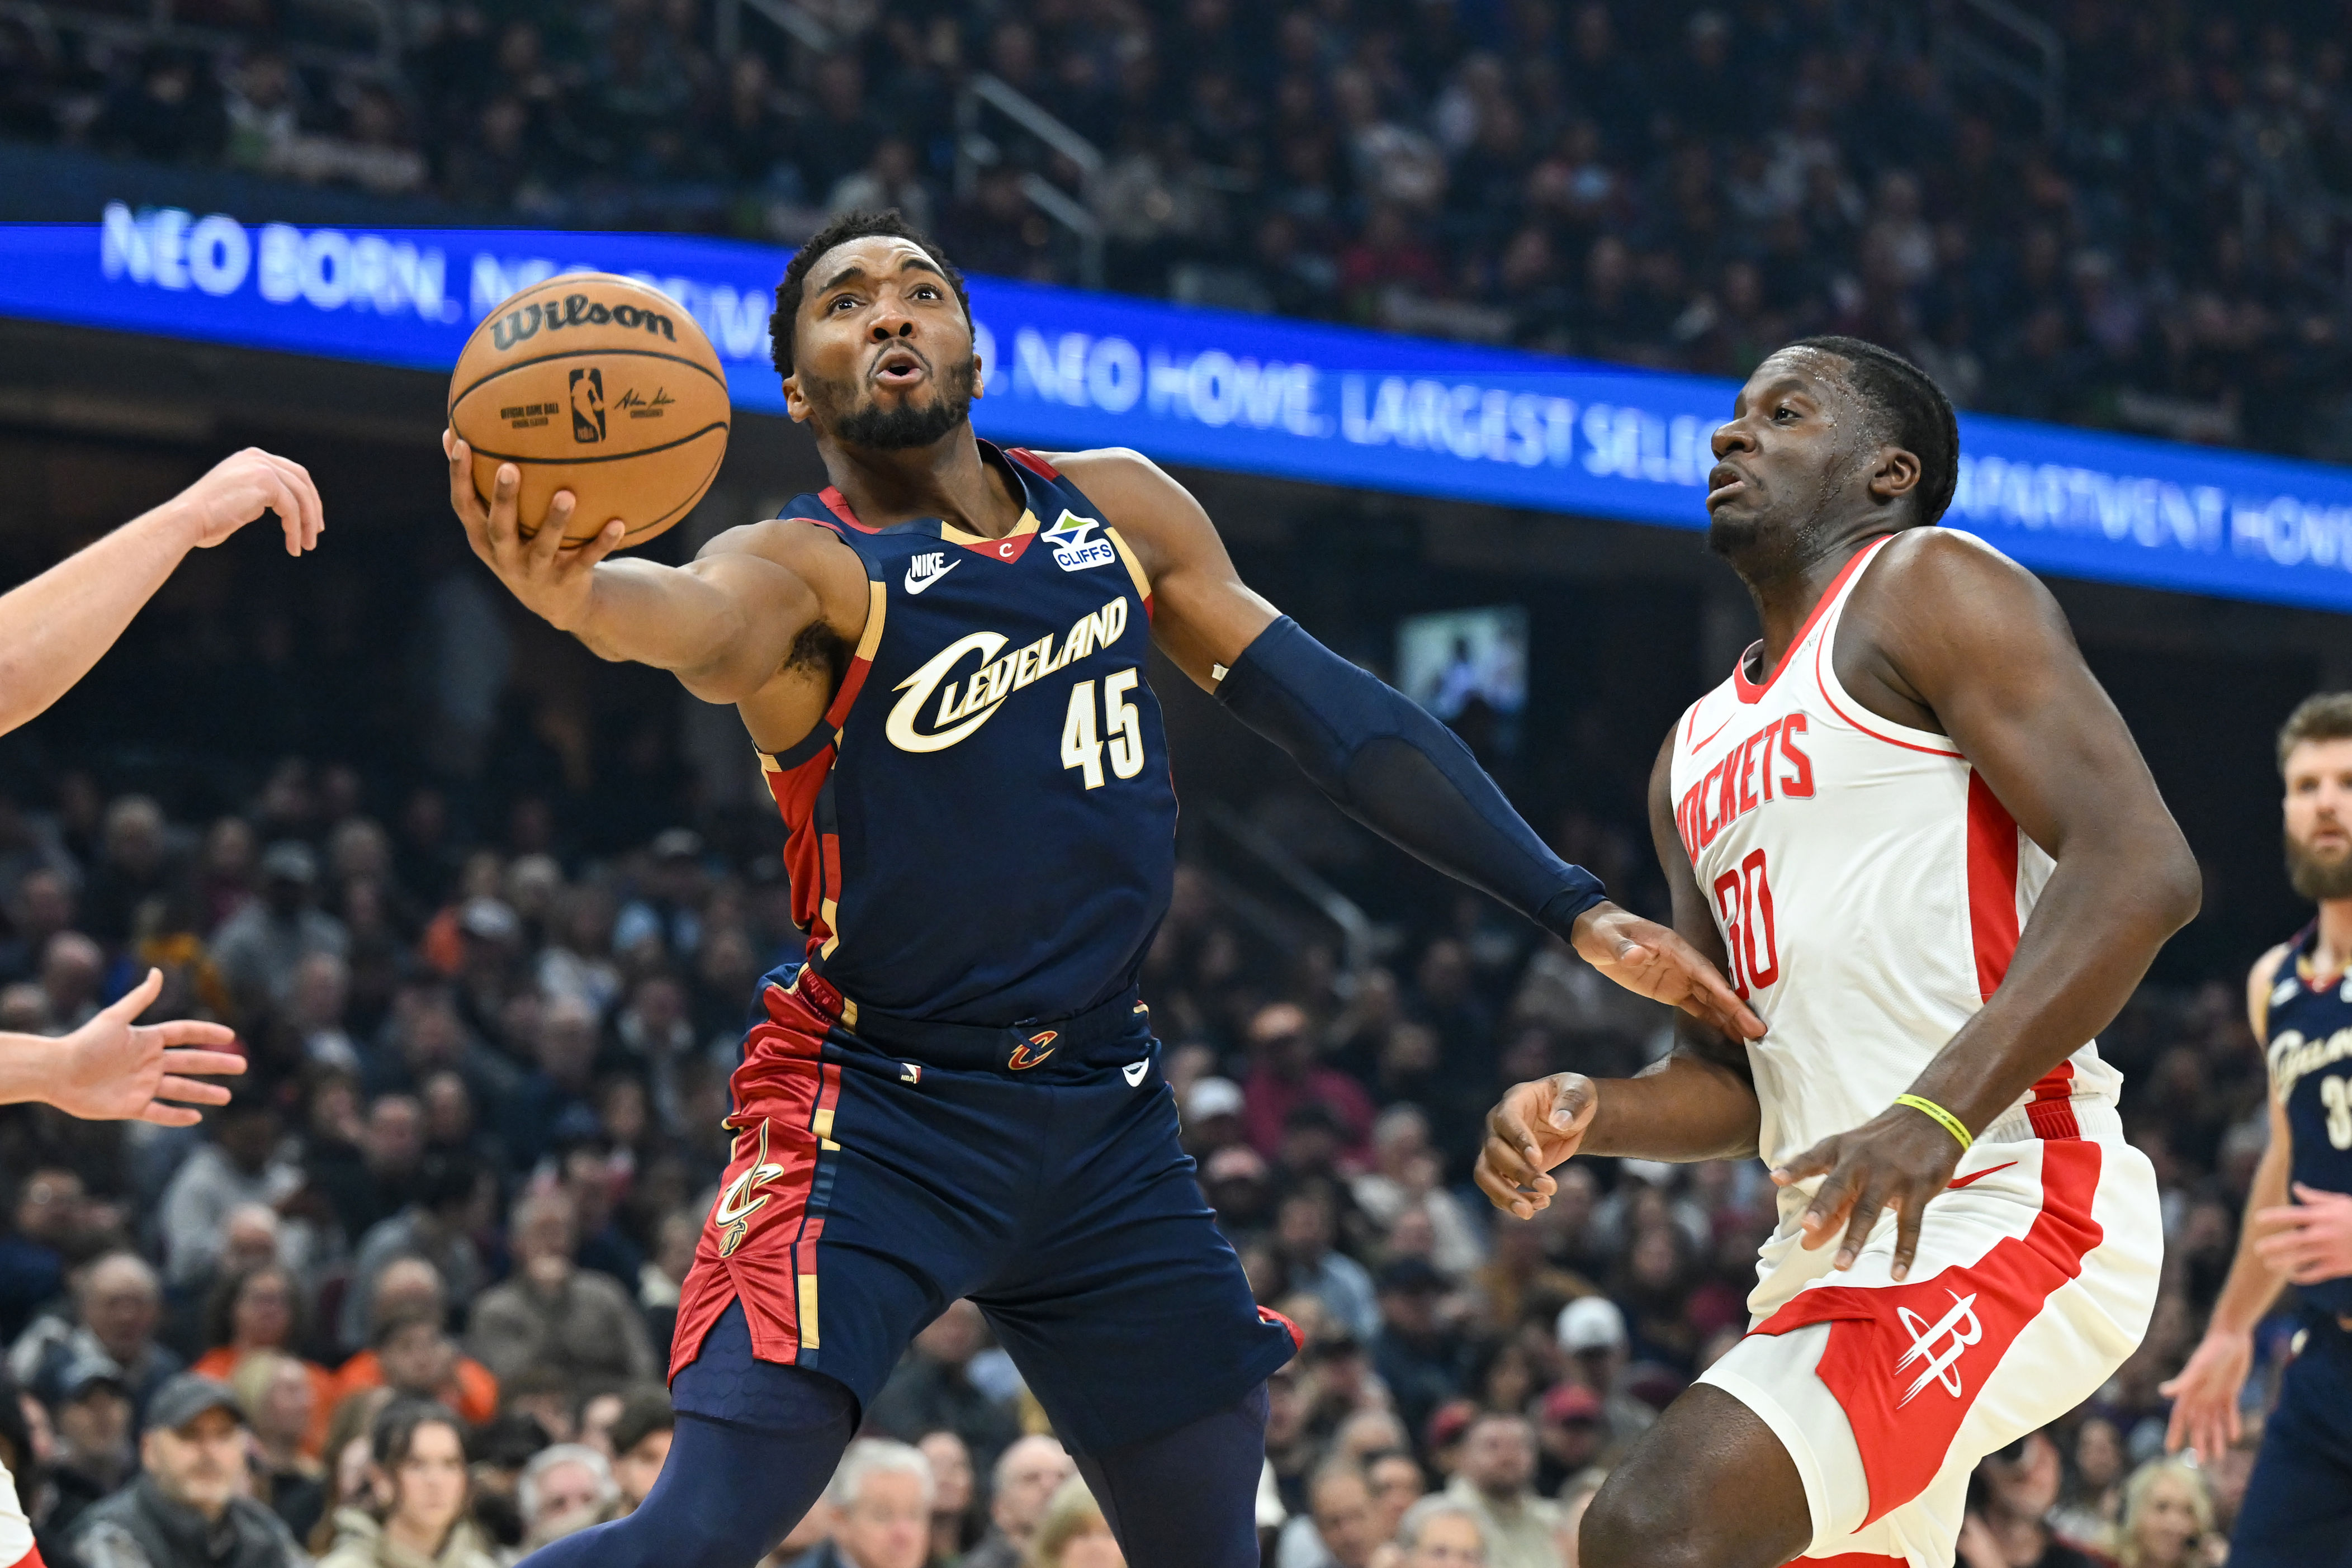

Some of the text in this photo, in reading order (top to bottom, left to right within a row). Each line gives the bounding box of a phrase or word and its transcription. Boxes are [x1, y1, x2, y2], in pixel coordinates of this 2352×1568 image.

[102, 202, 250, 296] NEO
[490, 293, 676, 350] Wilson
[1014, 327, 1142, 414] NEO
[1342, 375, 1575, 468] LARGEST
[911, 552, 944, 577] NIKE
[1057, 544, 1112, 566] CLIFFS
[1061, 667, 1144, 790] 45
